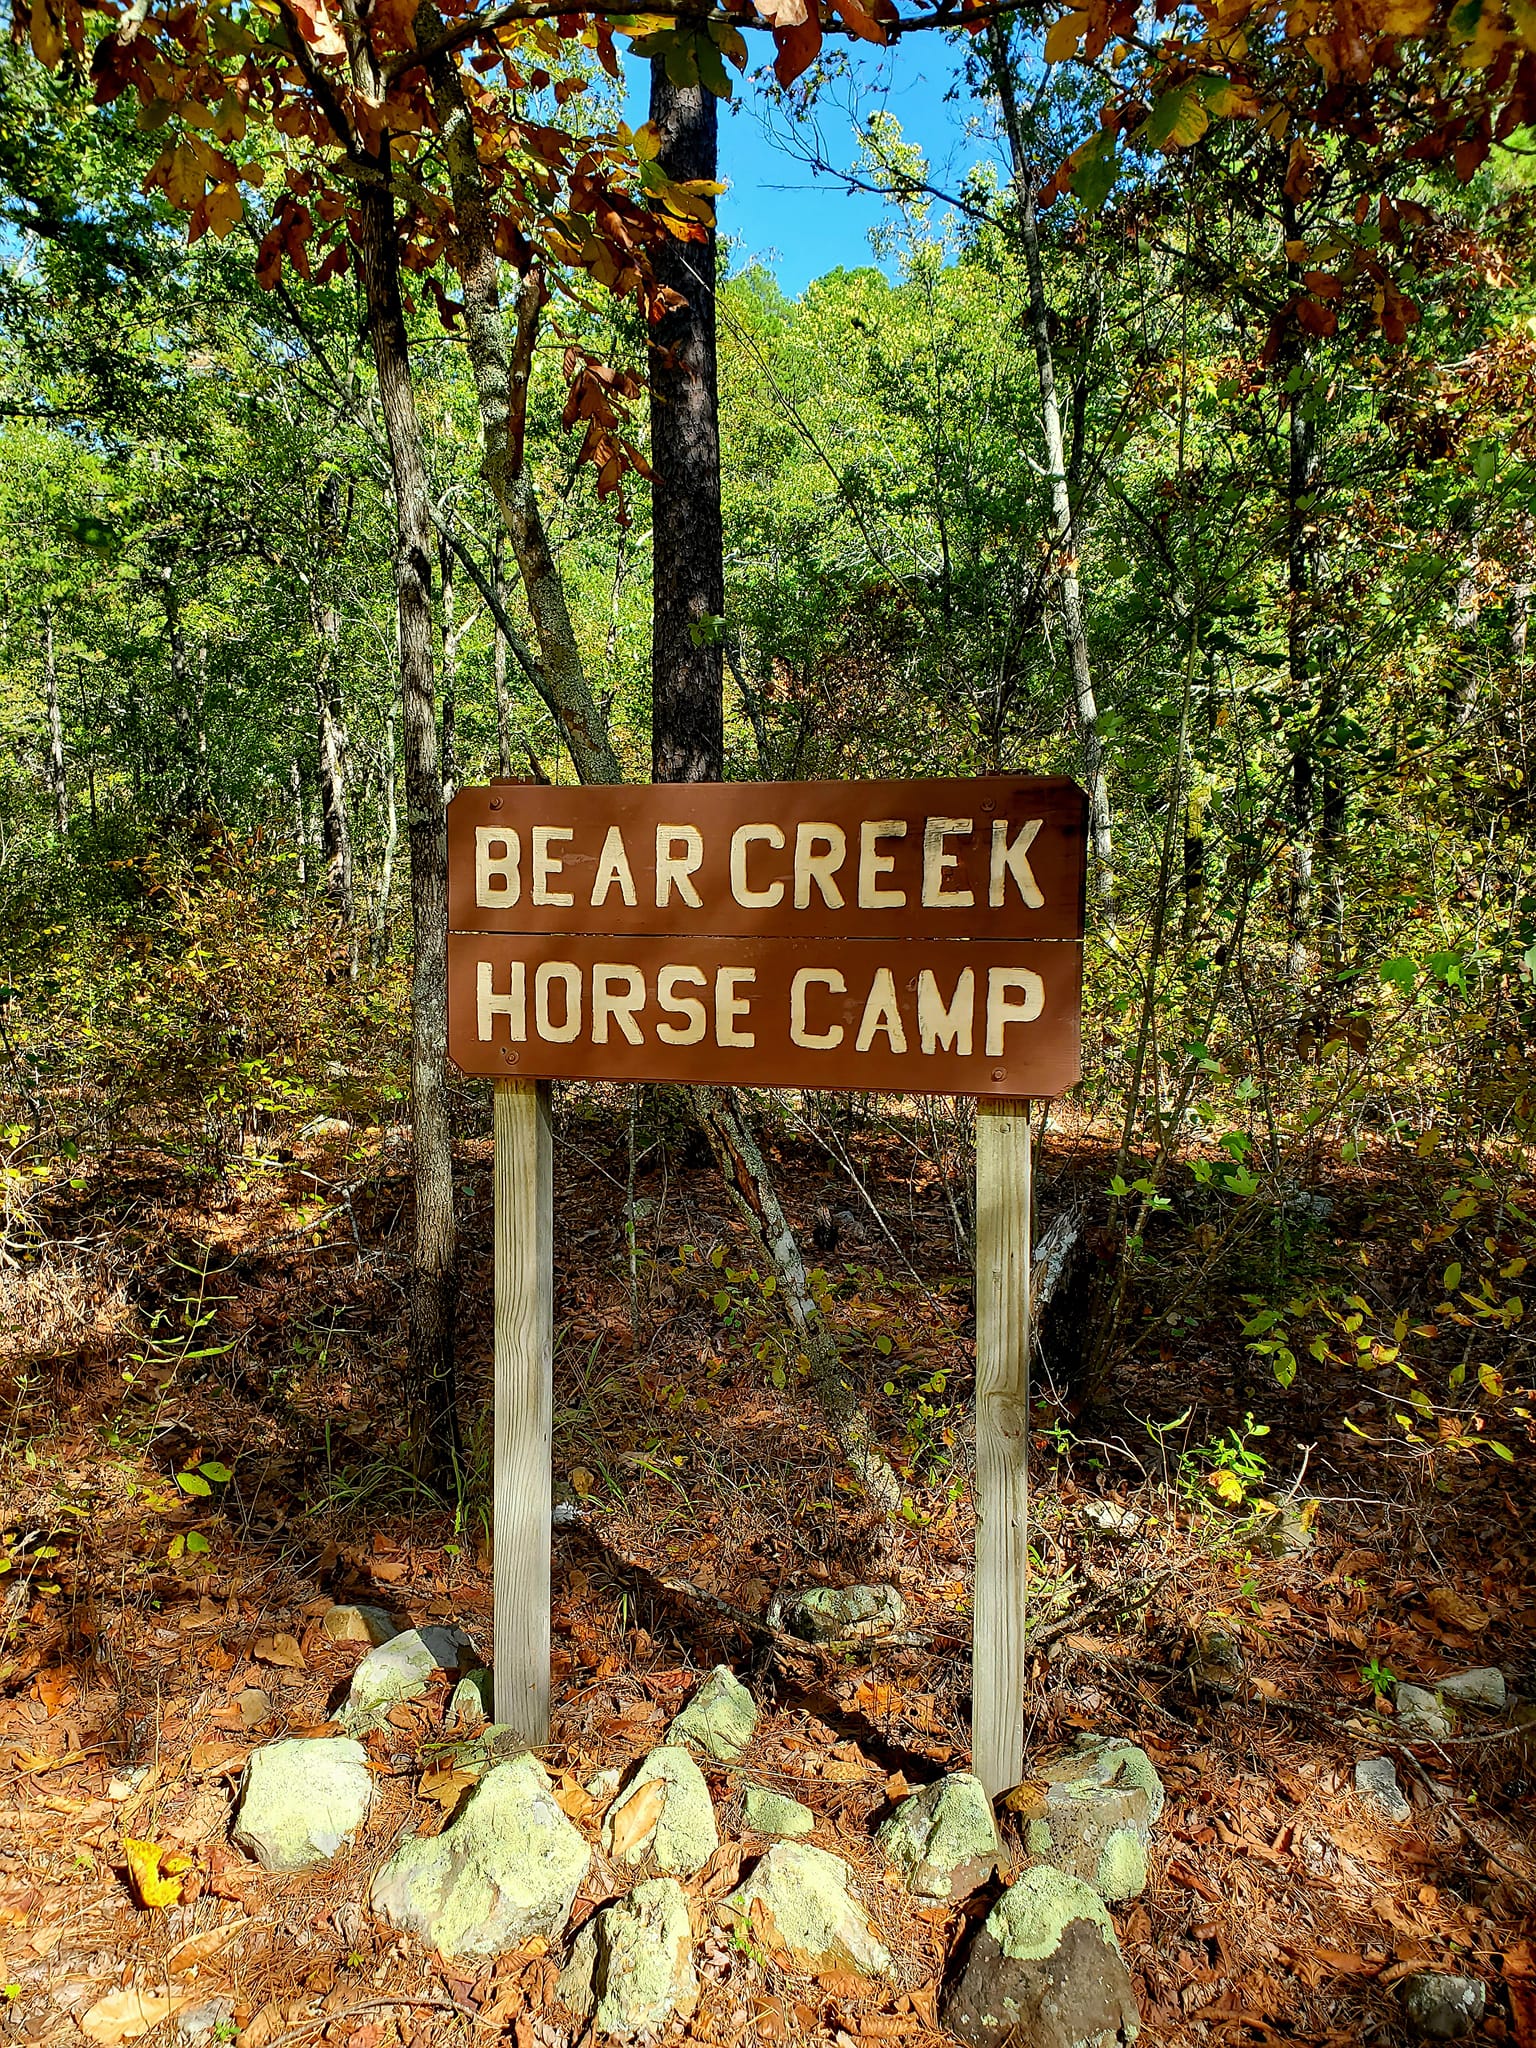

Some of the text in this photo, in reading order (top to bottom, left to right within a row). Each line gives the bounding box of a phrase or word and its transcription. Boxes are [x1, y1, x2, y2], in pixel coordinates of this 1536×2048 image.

[475, 816, 1045, 909] BEAR CREEK
[476, 961, 1045, 1057] HORSE CAMP
